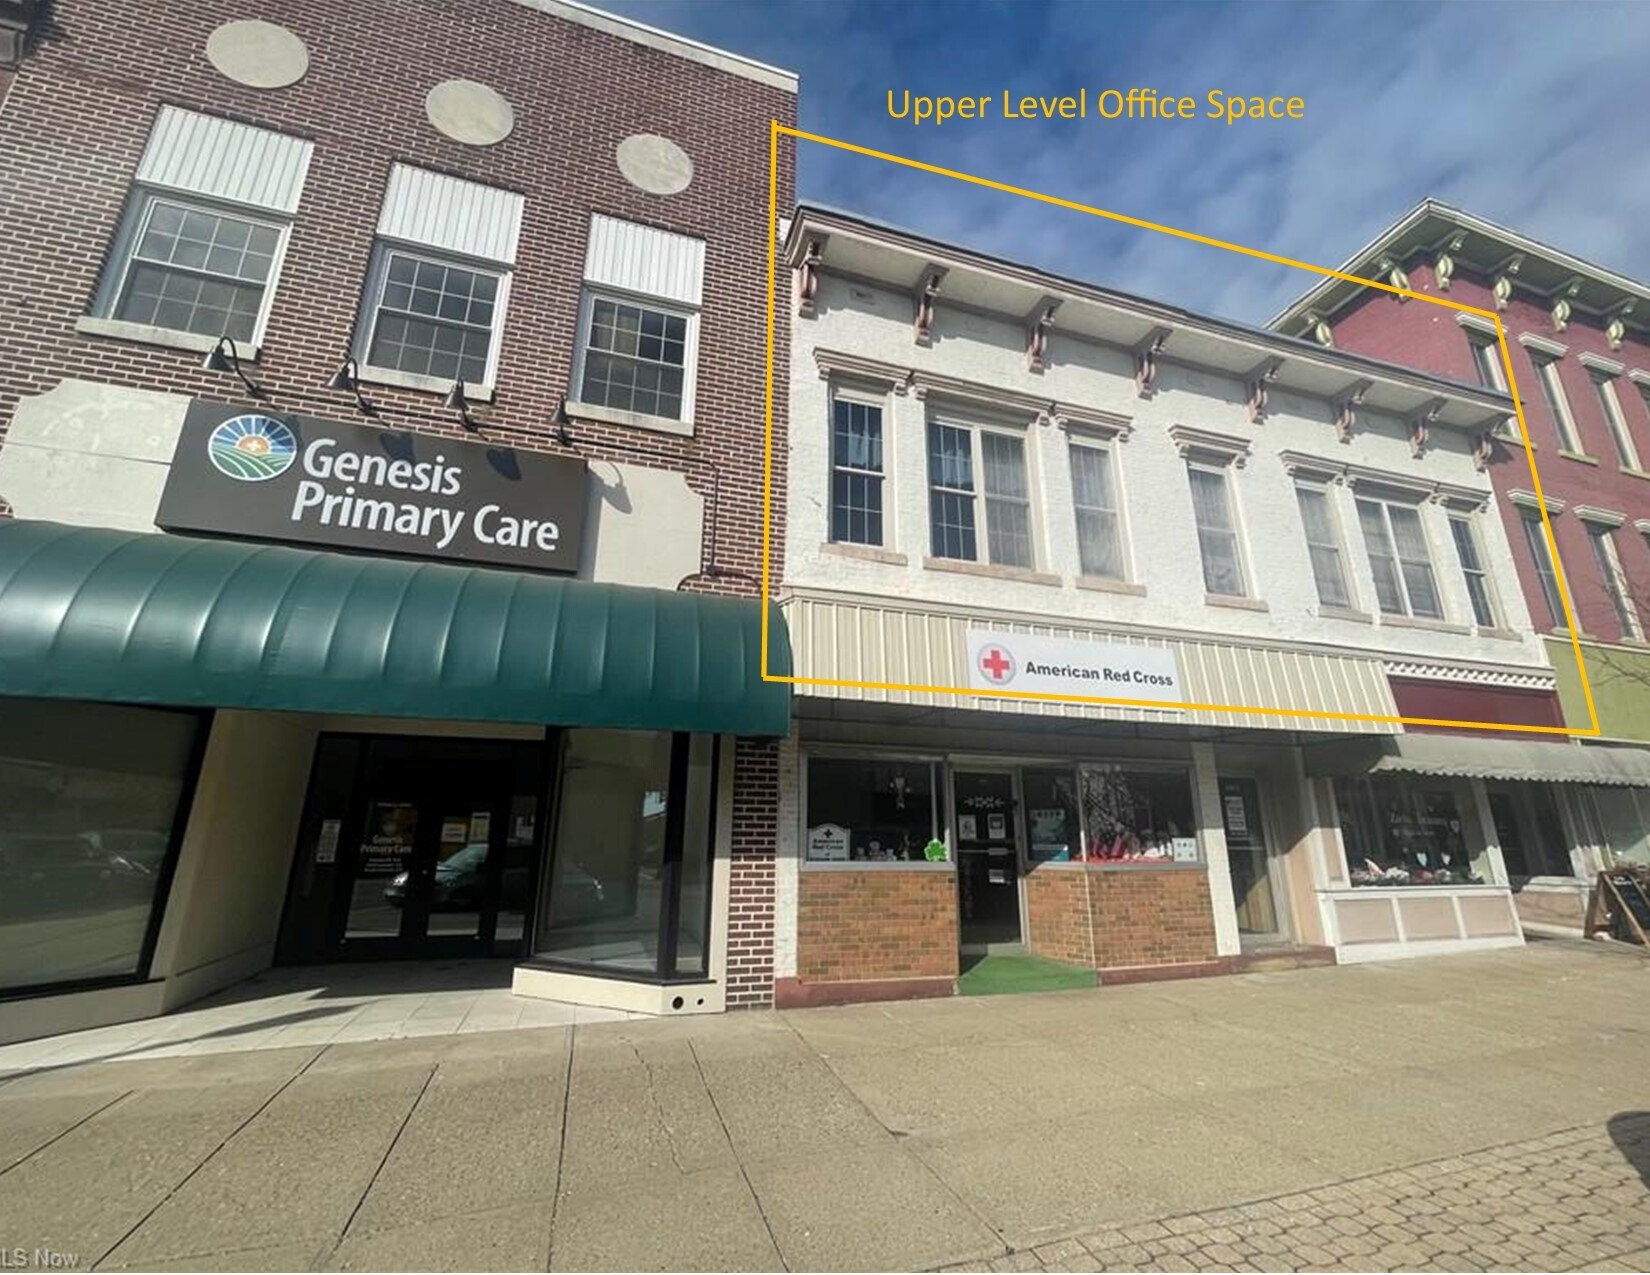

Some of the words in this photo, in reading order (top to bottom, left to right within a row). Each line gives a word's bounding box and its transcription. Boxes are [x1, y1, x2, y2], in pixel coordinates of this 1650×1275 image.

[303, 438, 463, 495] Genesis
[291, 481, 465, 549] Primary
[473, 505, 560, 551] Care
[1025, 661, 1100, 680] American
[1103, 668, 1131, 683] Red
[1133, 671, 1174, 686] Cross
